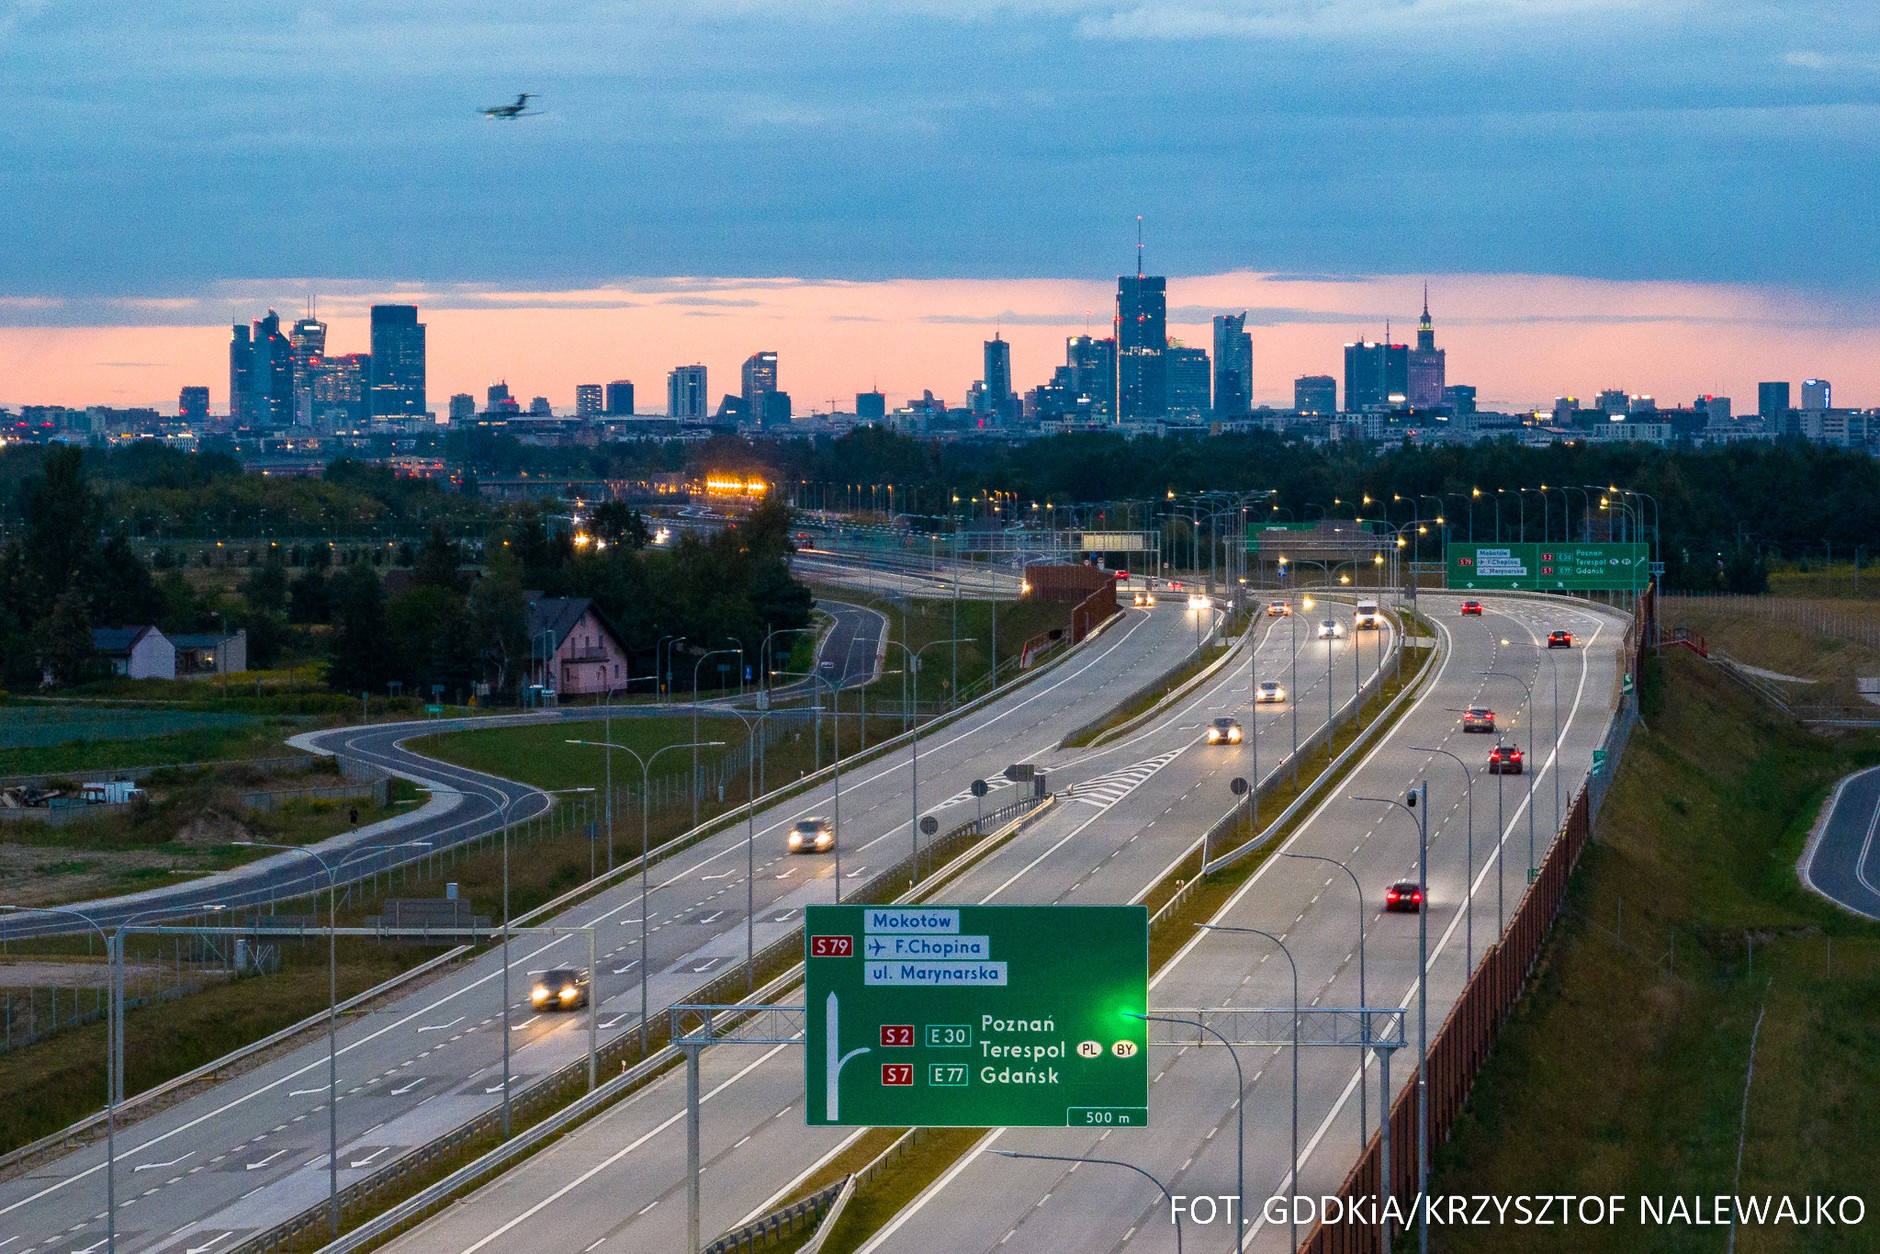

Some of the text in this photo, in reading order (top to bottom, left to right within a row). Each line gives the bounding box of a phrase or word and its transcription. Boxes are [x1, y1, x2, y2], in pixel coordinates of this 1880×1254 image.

[873, 913, 951, 928] Mokotów
[895, 939, 980, 957] F.Chopina
[873, 965, 998, 983] ul. Marynarska
[982, 1014, 1054, 1032] Poznań
[980, 1041, 1066, 1062] Terespol
[1082, 1044, 1096, 1055] PL
[1117, 1044, 1133, 1055] BY
[980, 1066, 1059, 1084] Gdańsk
[1086, 1112, 1129, 1124] 500 m
